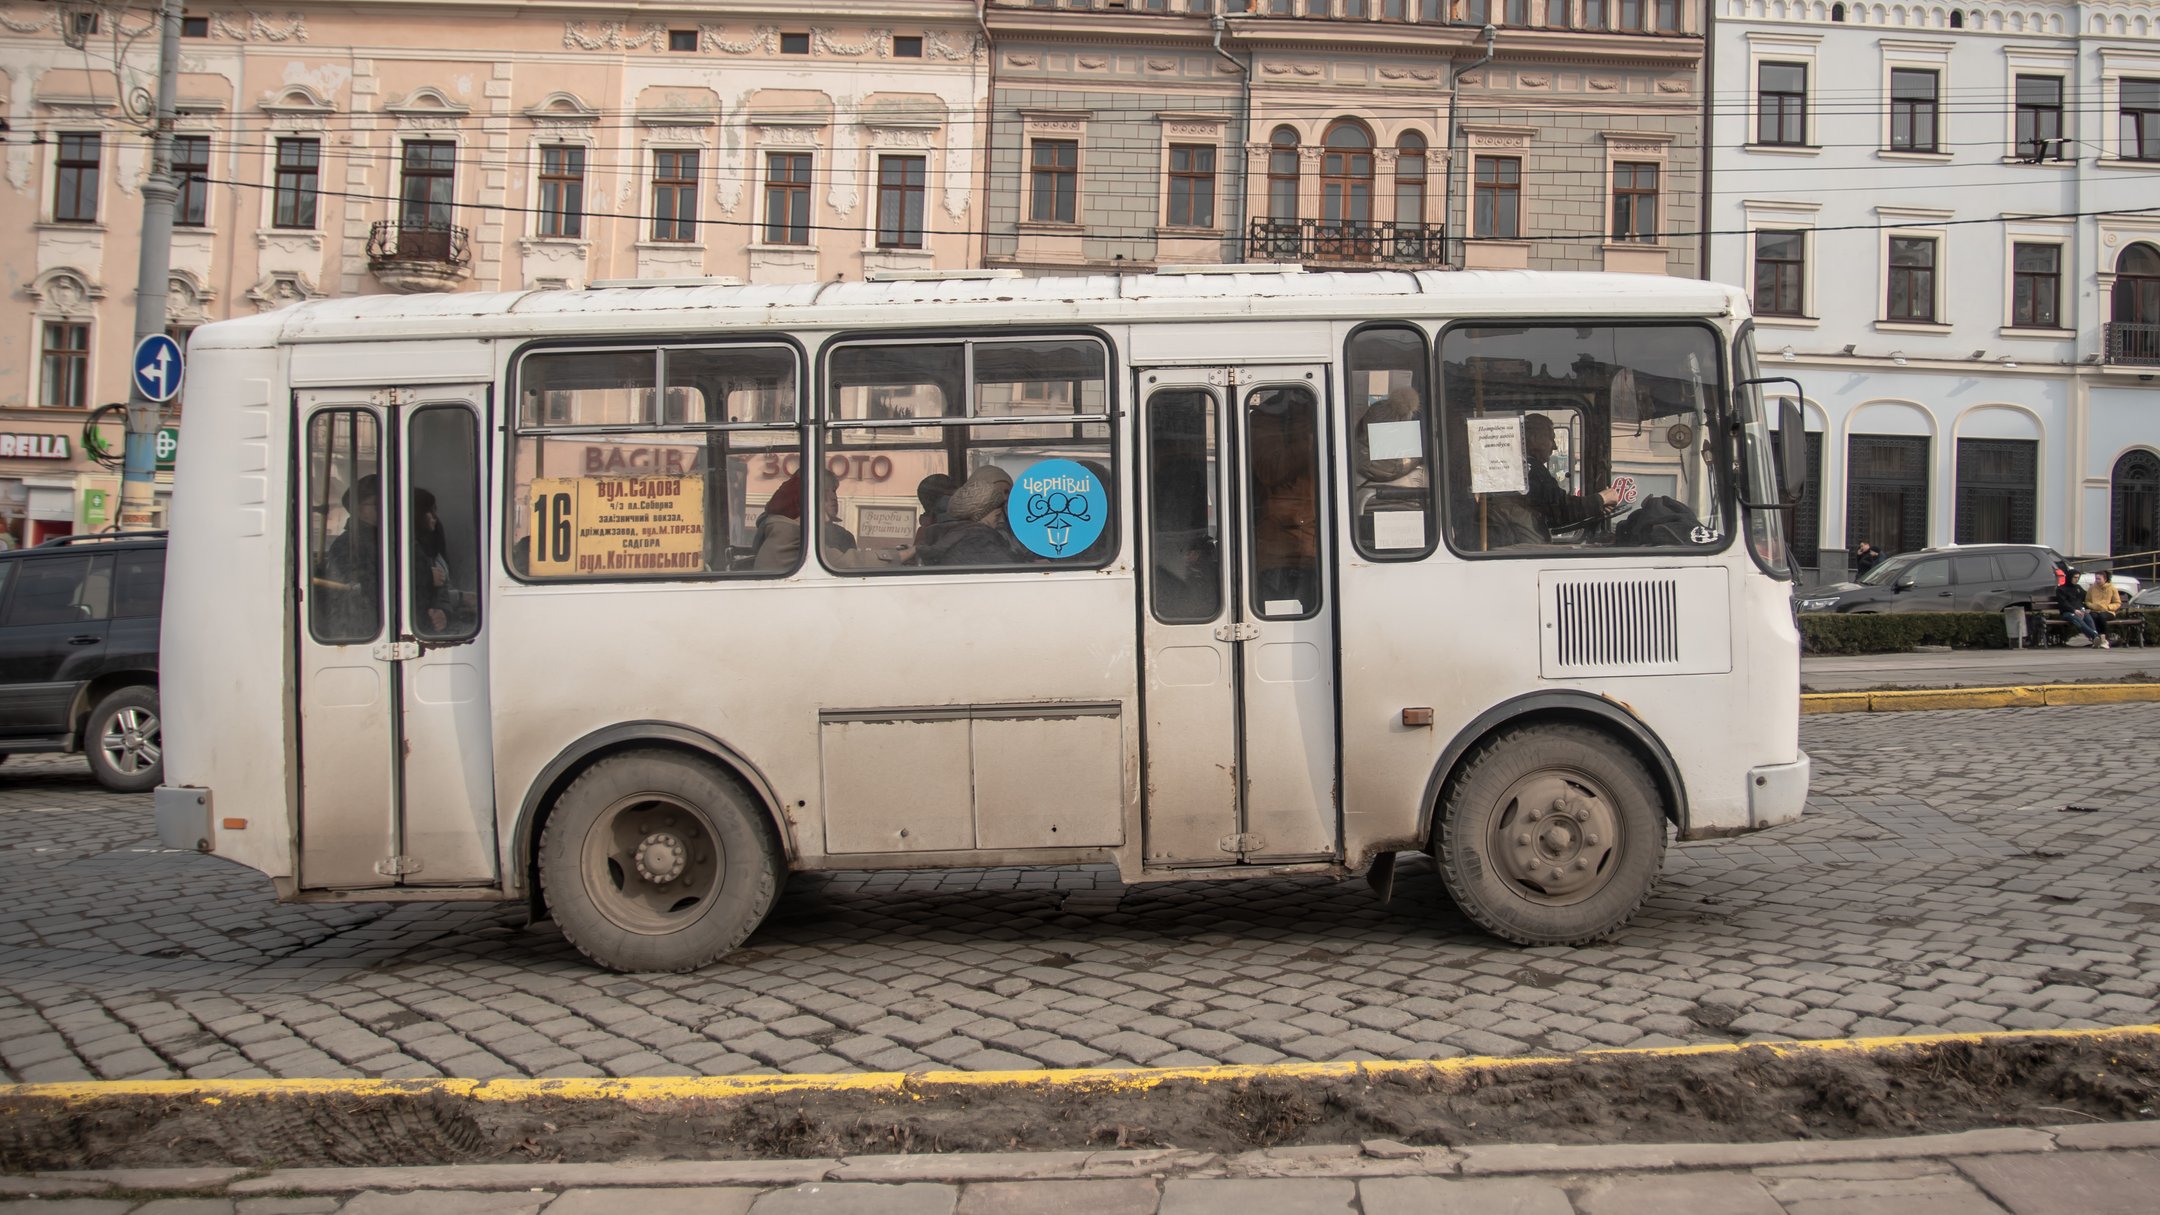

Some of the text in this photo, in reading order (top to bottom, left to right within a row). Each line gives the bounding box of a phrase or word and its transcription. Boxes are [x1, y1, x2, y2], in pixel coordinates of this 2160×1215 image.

[763, 453, 893, 482] ЗООТО
[598, 478, 681, 501] вул.Садова
[1023, 474, 1090, 497] Чернівці
[534, 492, 571, 562] 16
[599, 513, 684, 523] залізничний вокзал,
[622, 538, 660, 549] САДГОРА
[579, 550, 699, 574] вул.Квітковського
